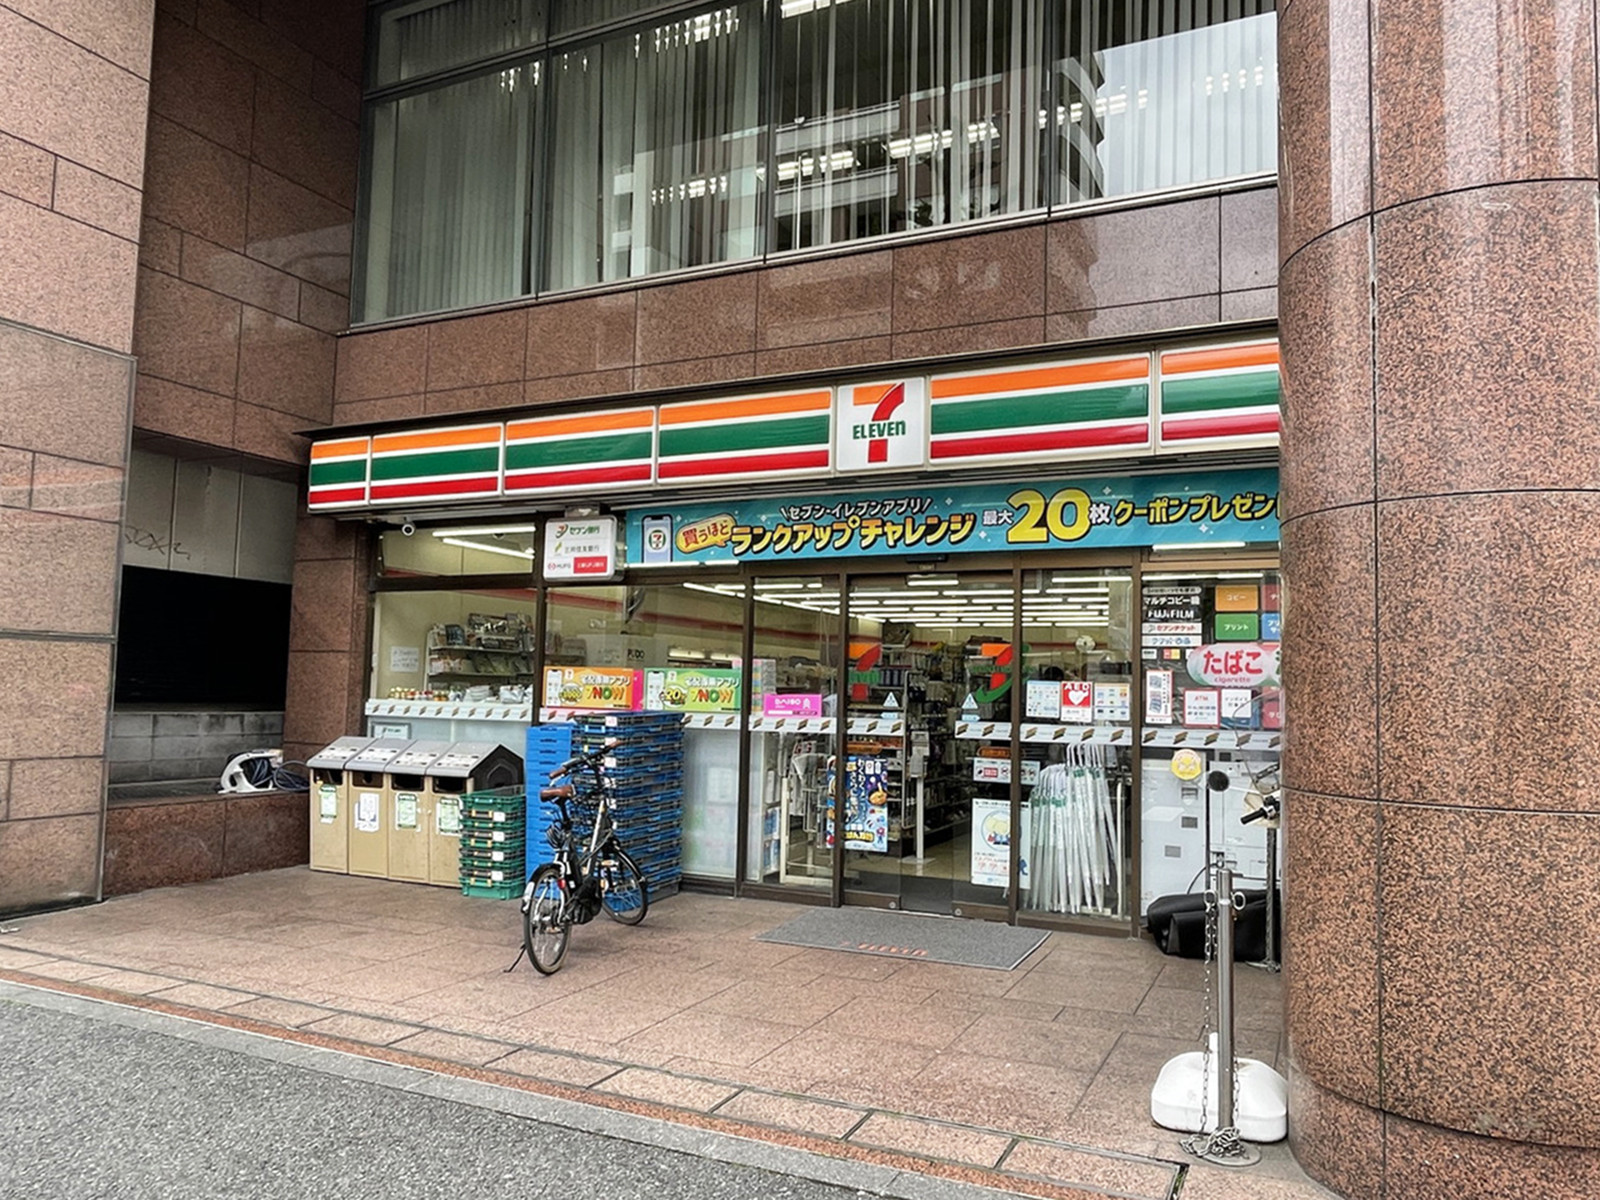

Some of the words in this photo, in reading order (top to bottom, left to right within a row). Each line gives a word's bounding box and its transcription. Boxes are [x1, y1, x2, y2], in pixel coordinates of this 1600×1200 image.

[853, 382, 904, 463] 7
[683, 521, 729, 547] 買うほど
[731, 514, 975, 555] ランクアップチャレンジ
[1203, 650, 1263, 675] たばこ
